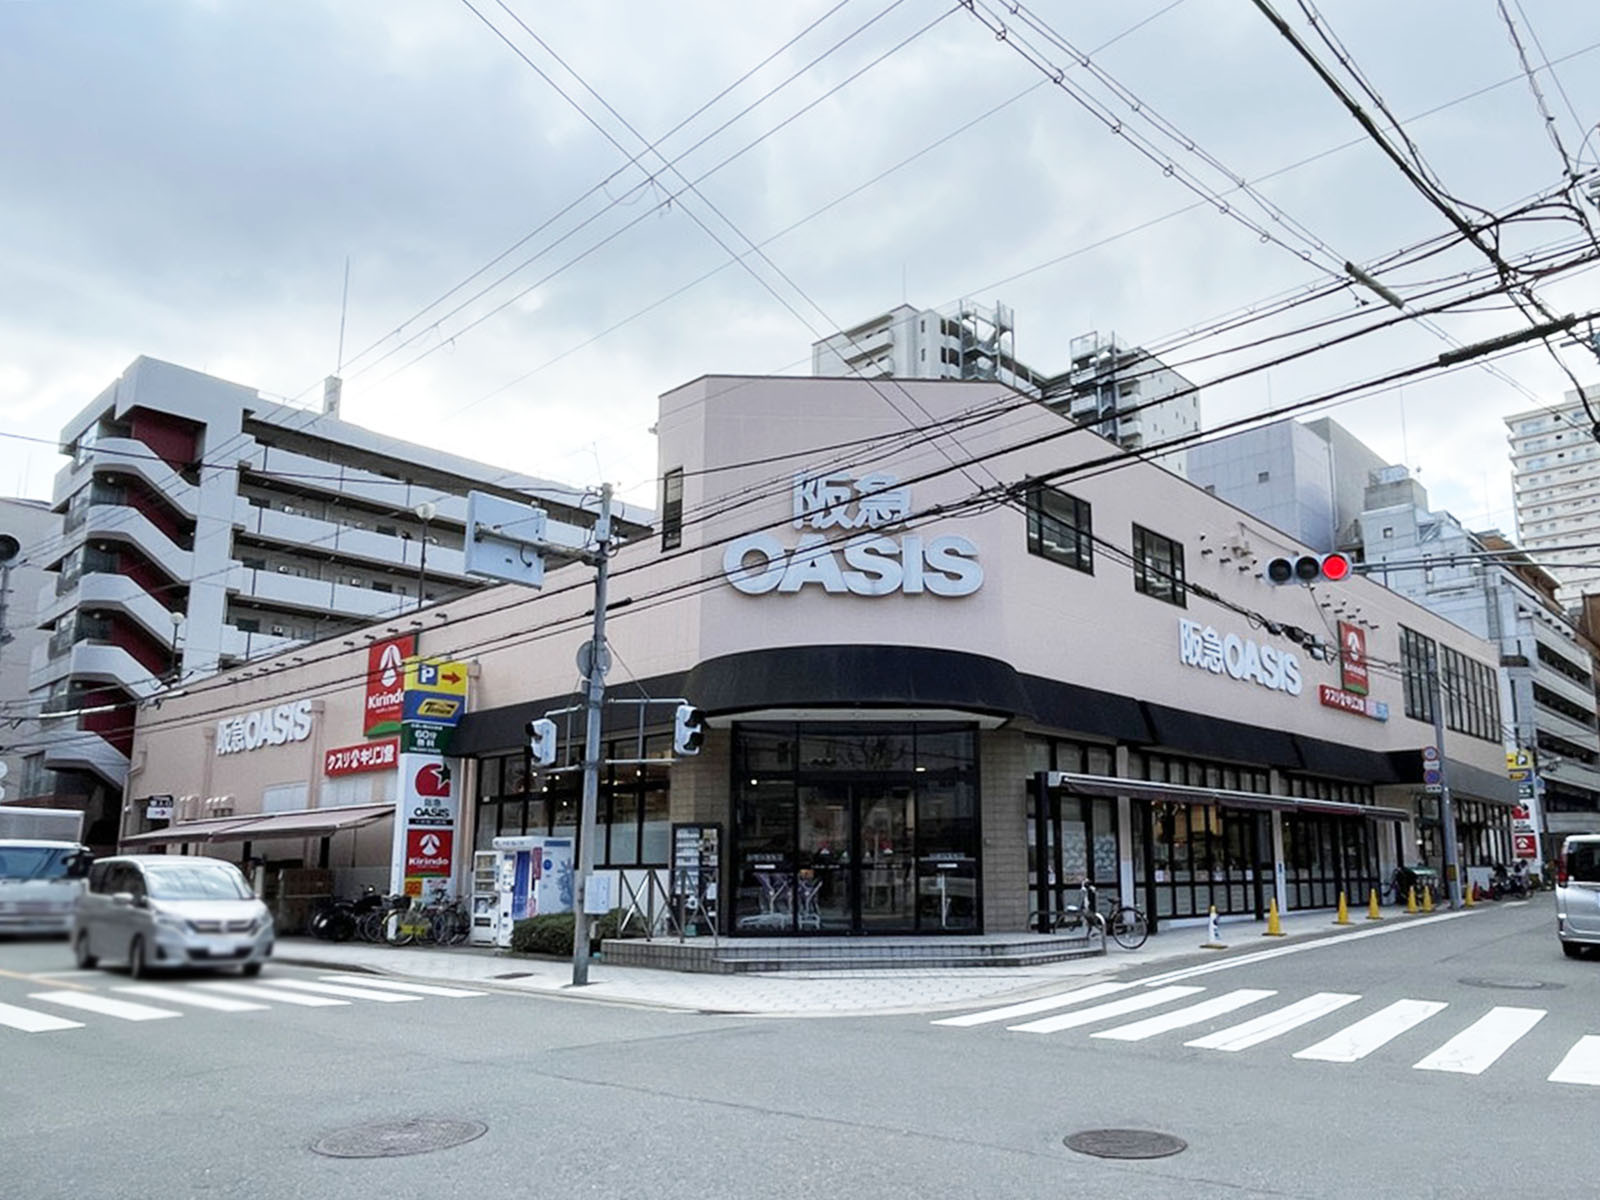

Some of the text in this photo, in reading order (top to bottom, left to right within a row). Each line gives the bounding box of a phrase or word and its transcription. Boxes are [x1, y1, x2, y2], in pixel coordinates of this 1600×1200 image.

[792, 472, 912, 531] 阪急
[723, 532, 985, 597] OASIS
[414, 807, 449, 817] OASIS
[408, 857, 449, 866] Kirindo
